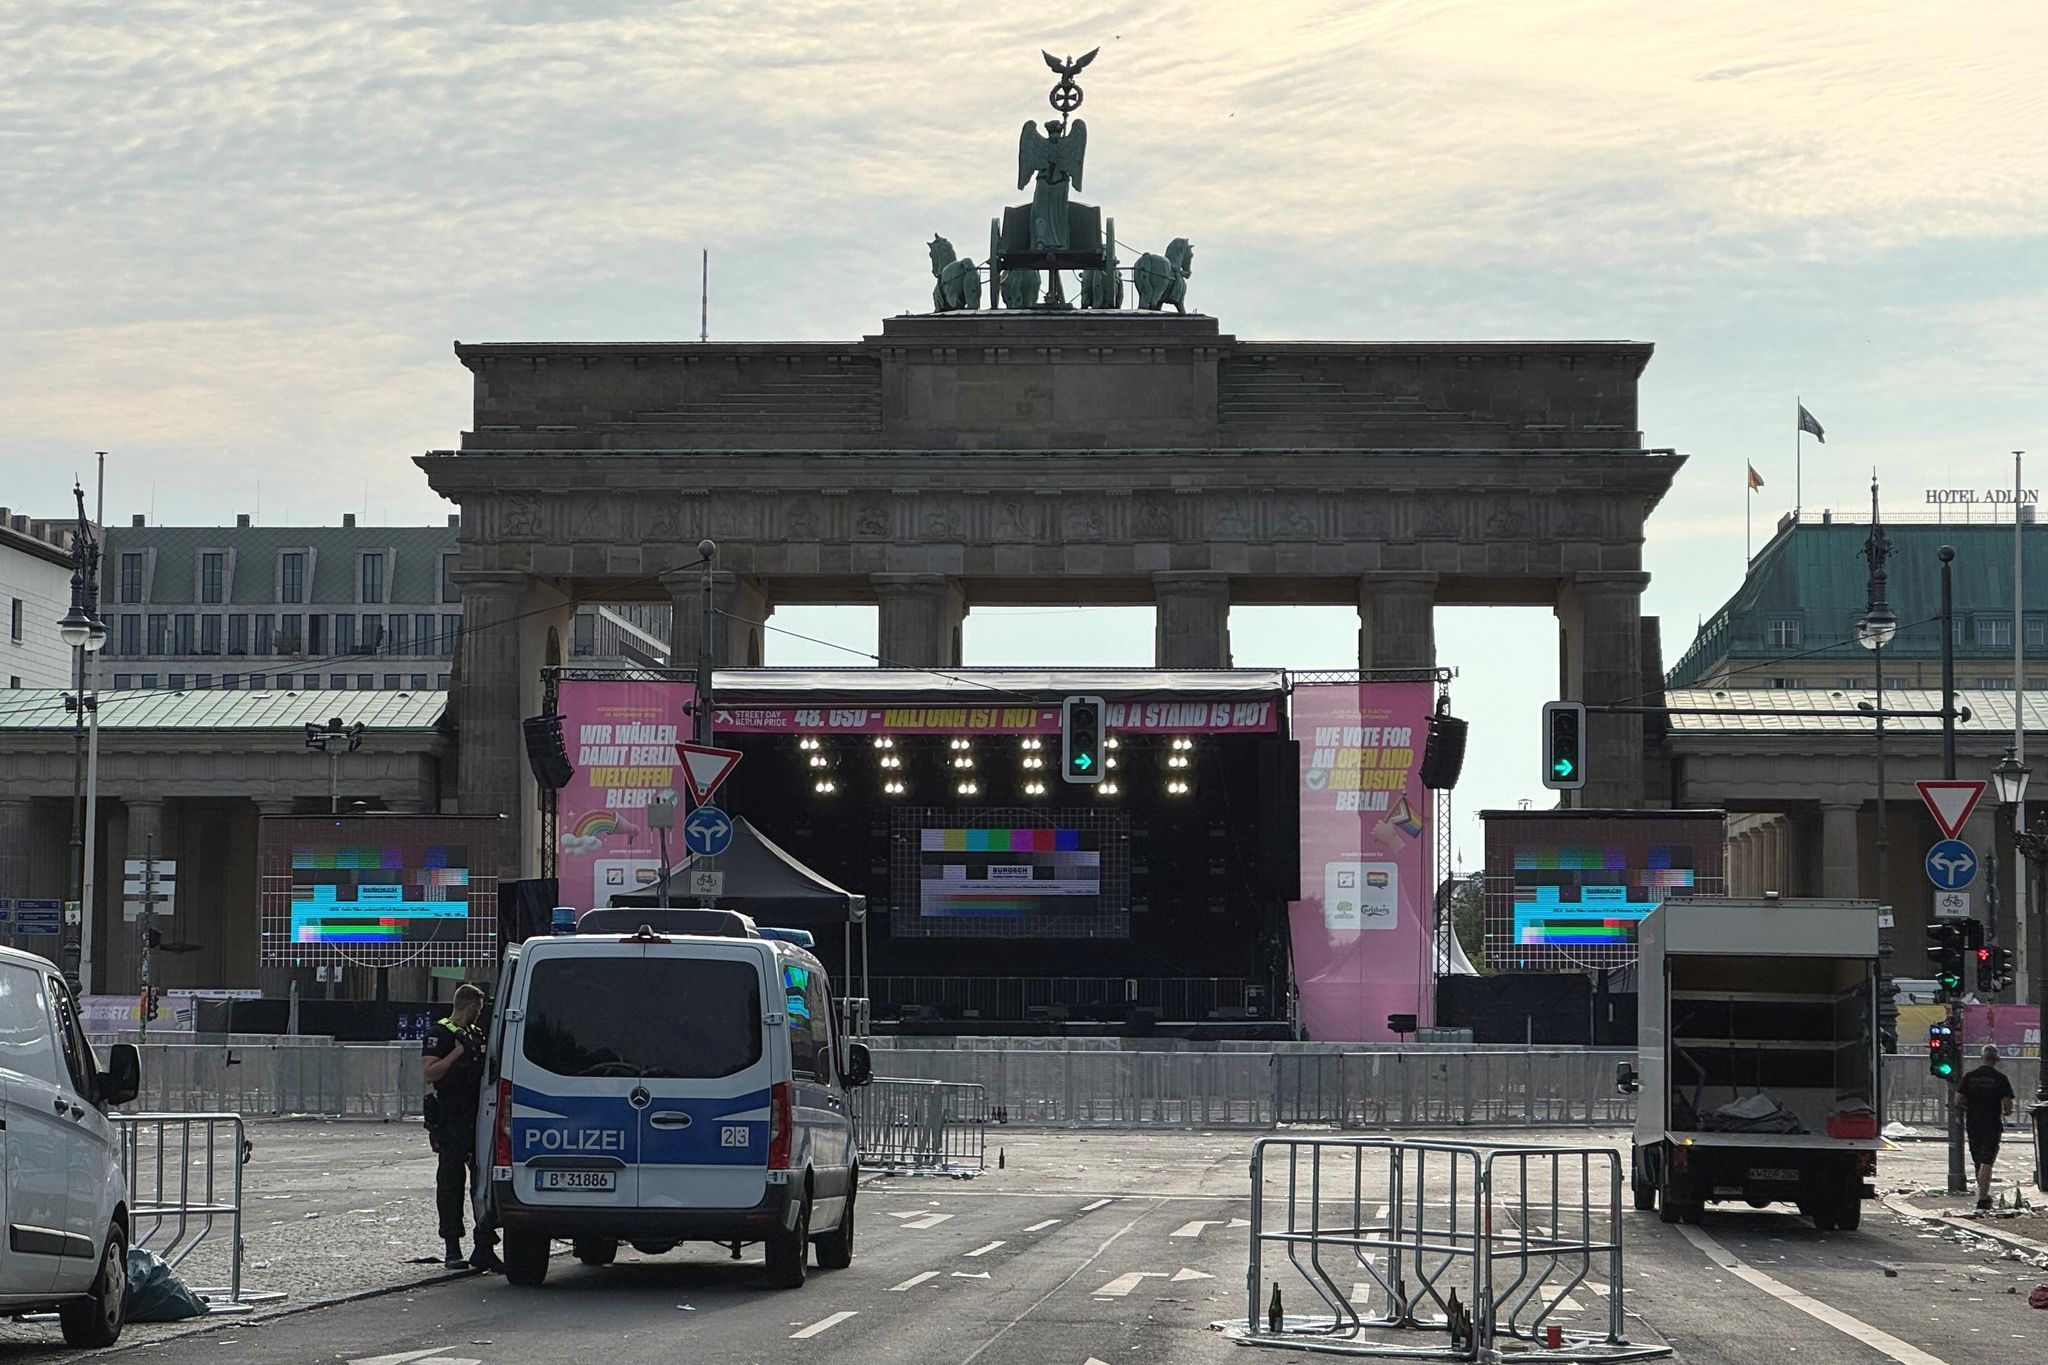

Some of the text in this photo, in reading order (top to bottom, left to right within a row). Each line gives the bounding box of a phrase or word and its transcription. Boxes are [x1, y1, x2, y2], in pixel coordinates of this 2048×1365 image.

[1925, 490, 2039, 503] HOTEL ADLON
[735, 710, 782, 719] STREET DAY
[735, 718, 788, 727] BERLIN PRIDE
[794, 709, 824, 728] 48.
[829, 709, 867, 728] CSD
[884, 709, 967, 728] HALTUNG
[968, 709, 999, 728] IST
[1002, 708, 1038, 728] HOT
[1126, 703, 1141, 728] A
[1145, 703, 1207, 728] STAND
[1210, 702, 1231, 727] IS
[1233, 701, 1271, 727] HOT
[579, 724, 612, 745] WIR
[1315, 726, 1413, 747] WE VOTE FOR
[578, 746, 629, 766] DAMIT
[1311, 748, 1414, 769] AN OPEN AND
[589, 767, 674, 788] WELTOFFEN
[1328, 769, 1409, 790] INCLUSIVE
[606, 788, 657, 809] BLEIBT
[1335, 791, 1390, 811] BERLIN
[1360, 904, 1390, 916] Carlsberg
[525, 1129, 625, 1150] POLIZEI
[723, 1128, 747, 1145] 23
[550, 1173, 608, 1187] B 31886
